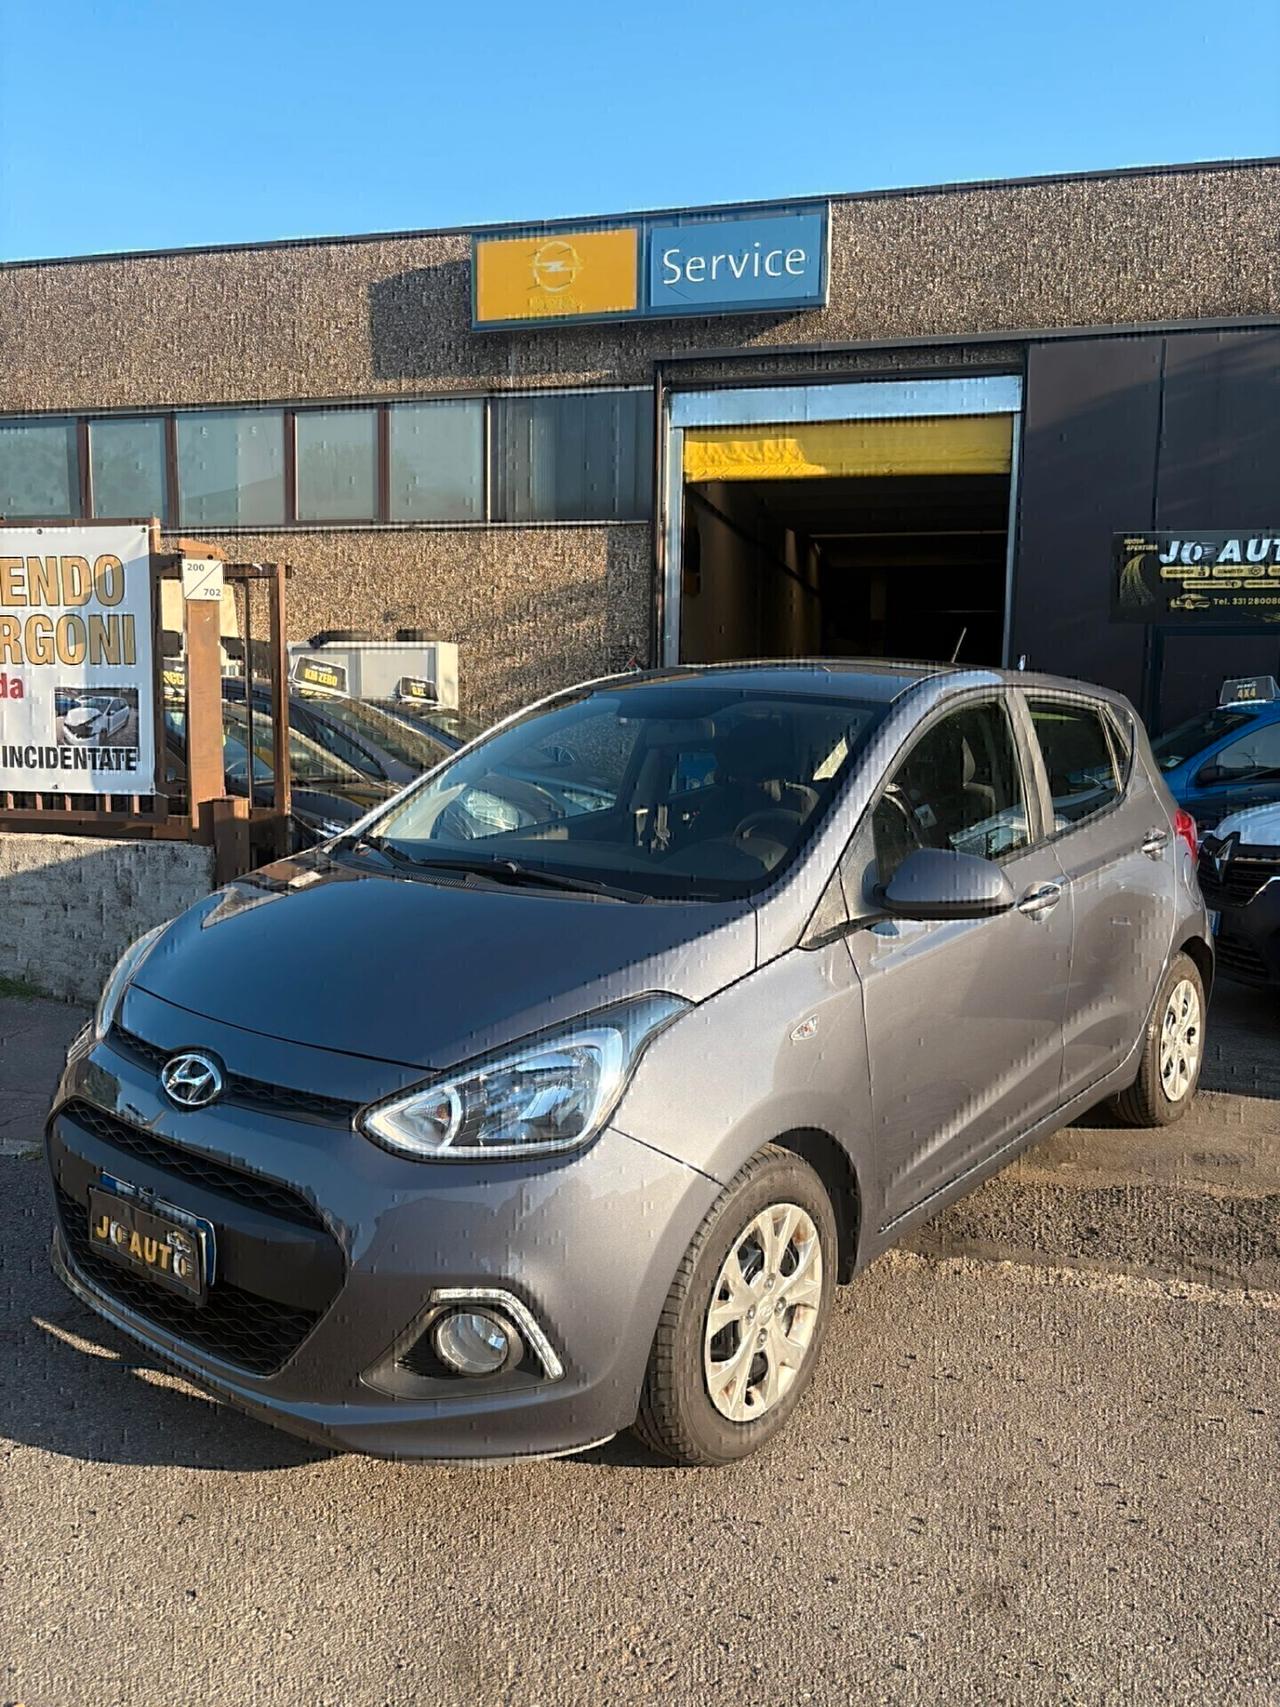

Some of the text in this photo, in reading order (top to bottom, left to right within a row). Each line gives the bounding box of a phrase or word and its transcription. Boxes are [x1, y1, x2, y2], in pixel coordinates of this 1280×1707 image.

[663, 242, 806, 285] Service
[0, 554, 125, 607] ENDO
[187, 563, 205, 572] 200
[203, 588, 222, 597] 702
[1213, 597, 1230, 605] Tel.
[0, 614, 137, 666] RGONI
[2, 745, 138, 771] INCIDENTATE
